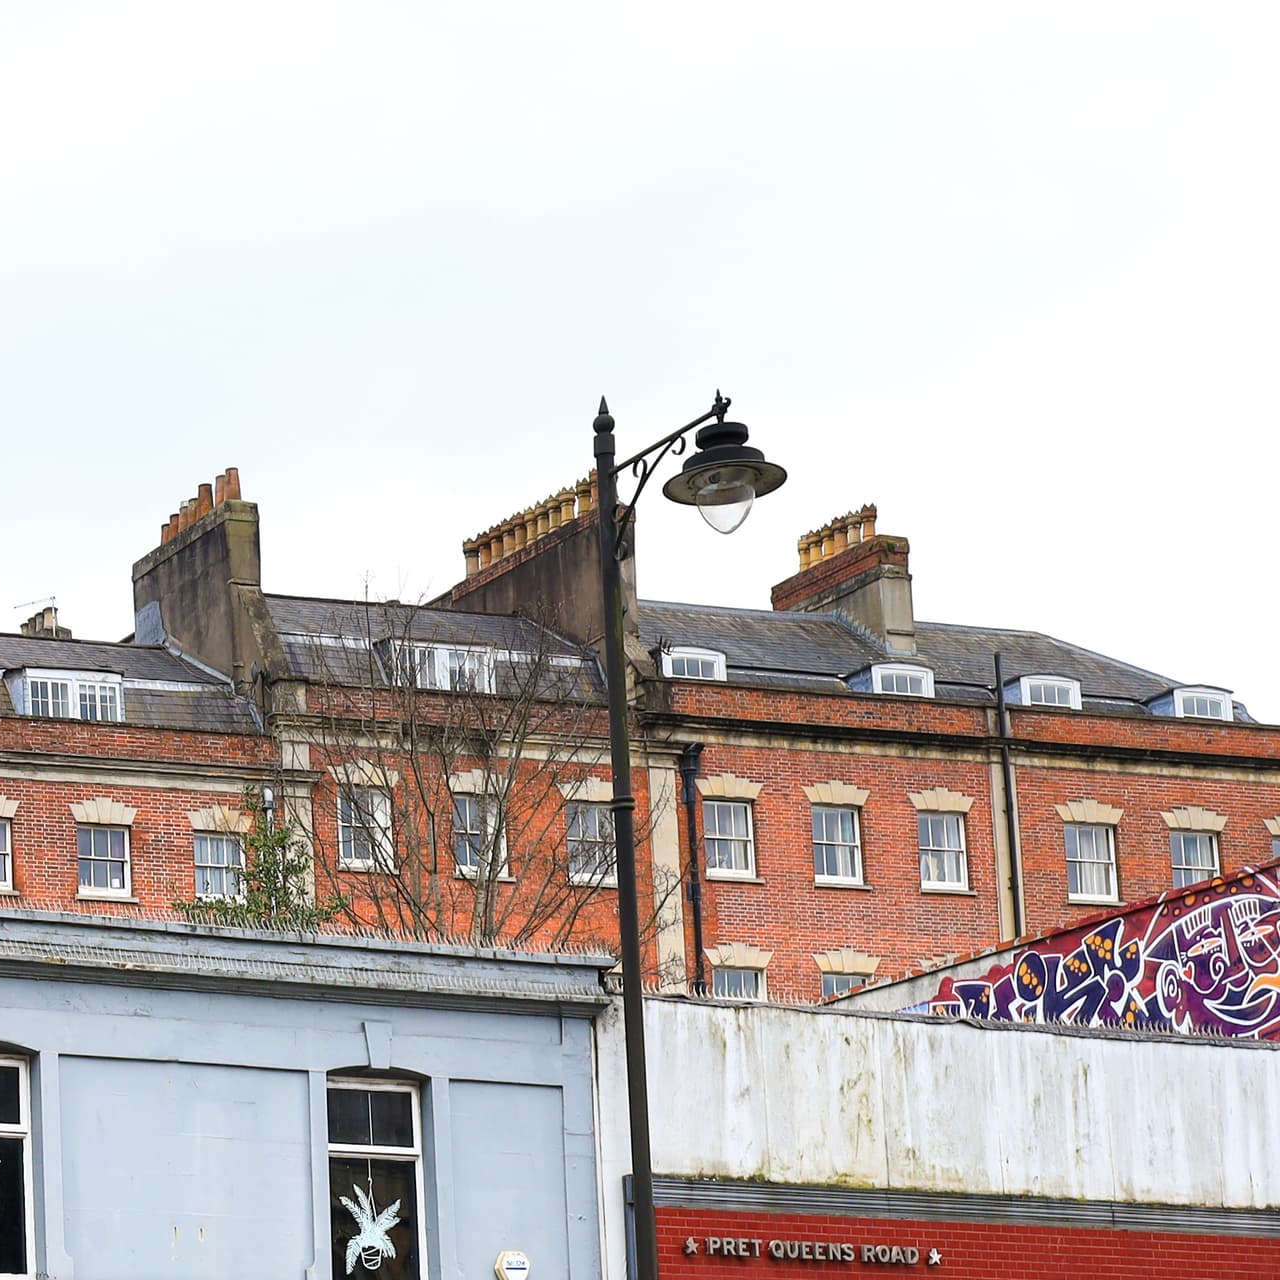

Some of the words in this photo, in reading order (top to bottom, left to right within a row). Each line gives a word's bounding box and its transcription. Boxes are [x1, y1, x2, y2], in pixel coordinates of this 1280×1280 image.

[706, 1236, 762, 1257] PRET
[768, 1239, 855, 1262] QUEENS
[861, 1244, 920, 1264] ROAD
